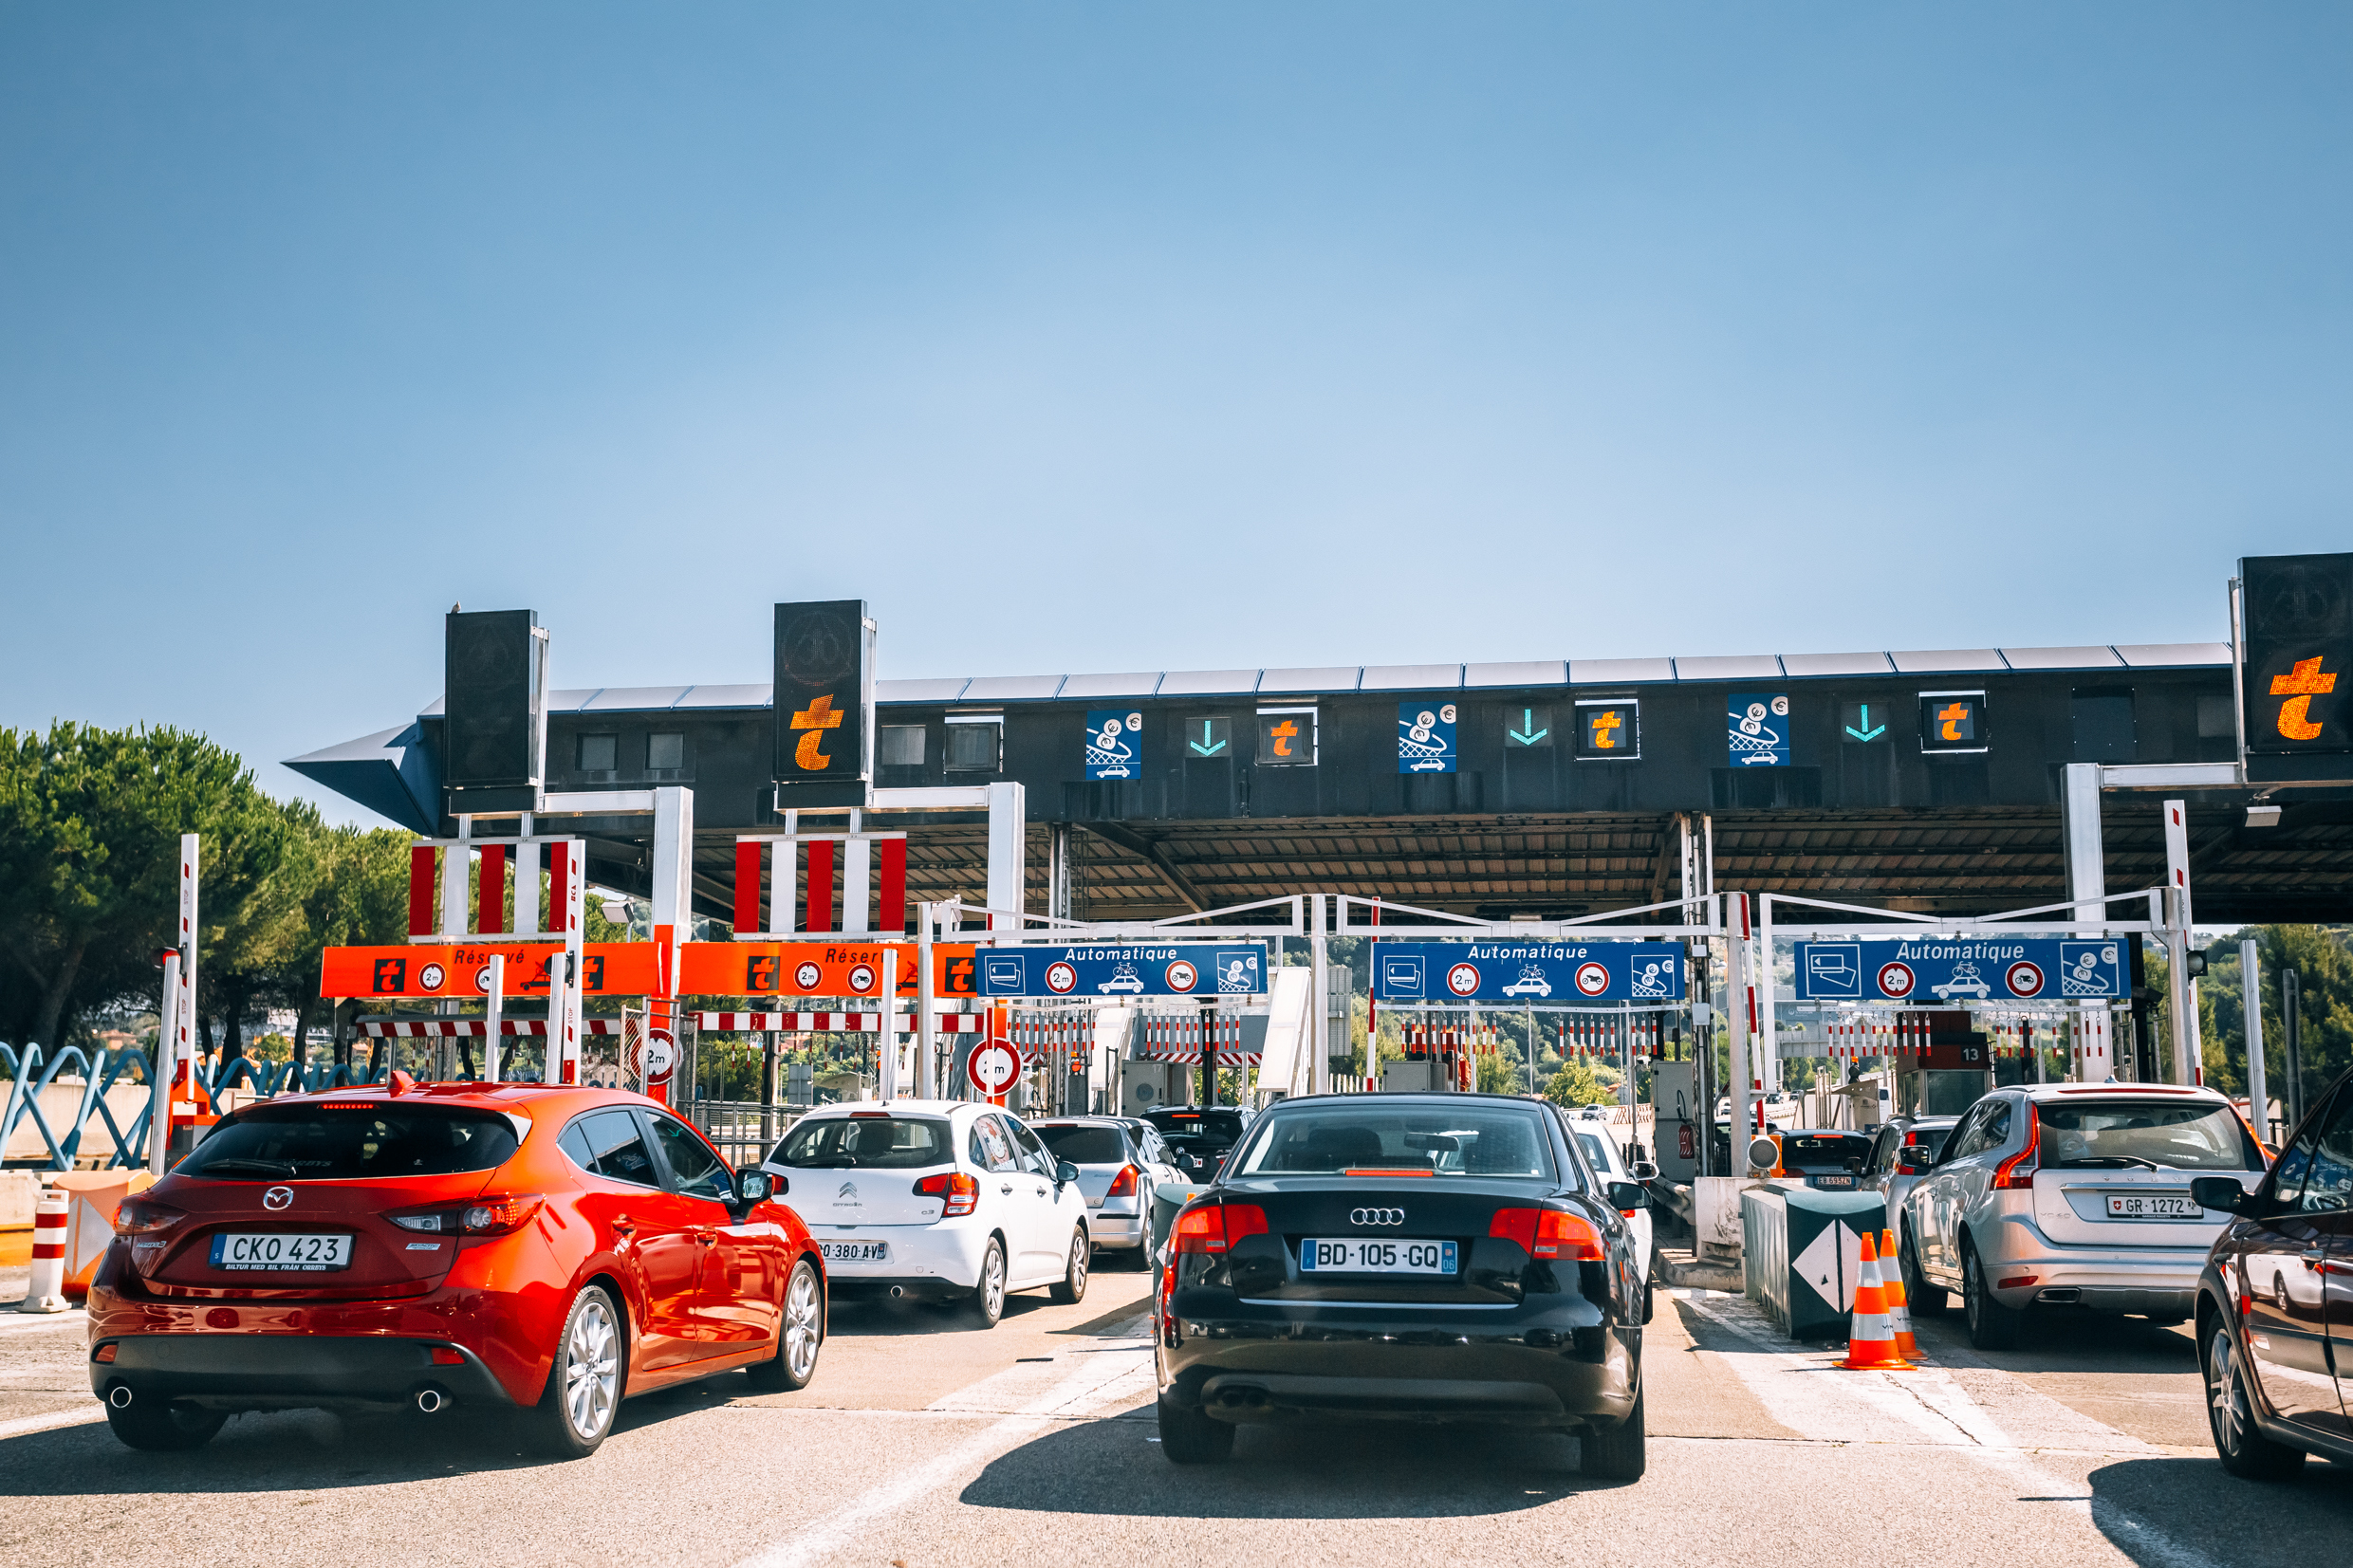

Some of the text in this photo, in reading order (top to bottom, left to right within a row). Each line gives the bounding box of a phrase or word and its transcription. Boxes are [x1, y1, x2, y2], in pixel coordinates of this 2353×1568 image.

[454, 949, 525, 965] Résvé
[1065, 948, 1177, 962] Automatique
[1467, 945, 1588, 961] Automatique
[1896, 941, 2025, 964] Automatique
[1962, 1047, 1979, 1061] 13
[1152, 1064, 1163, 1074] 17
[232, 1237, 340, 1262] CKO 423
[281, 1263, 300, 1271] FRÅN
[1442, 1259, 1455, 1270] 06
